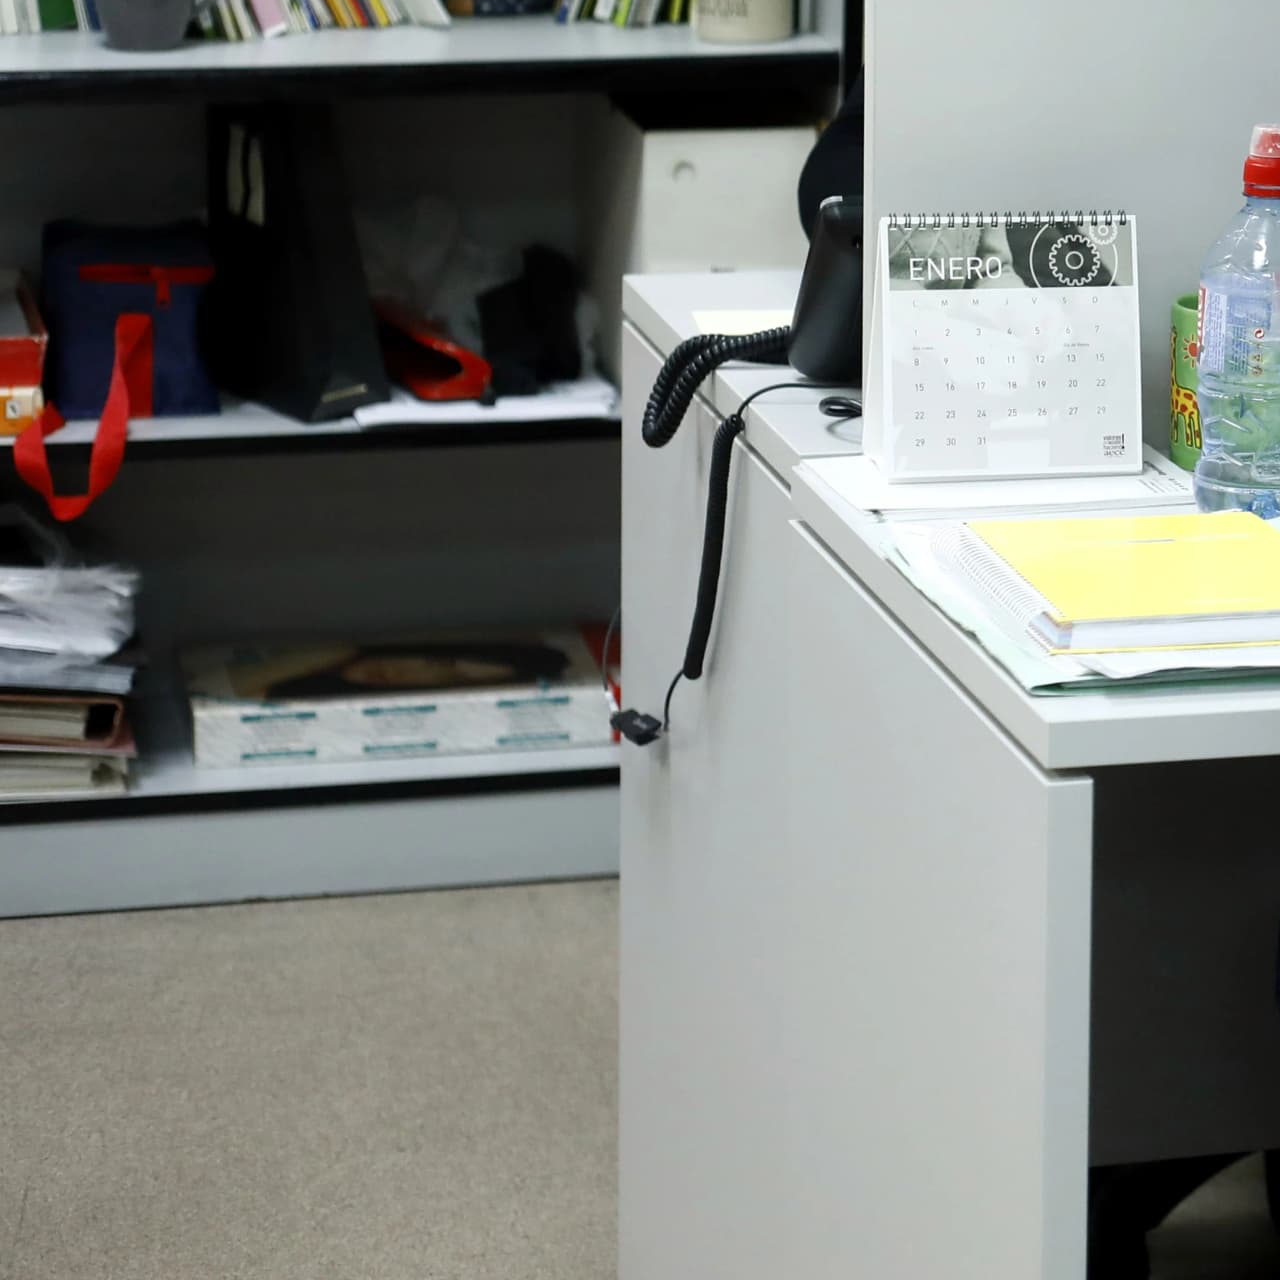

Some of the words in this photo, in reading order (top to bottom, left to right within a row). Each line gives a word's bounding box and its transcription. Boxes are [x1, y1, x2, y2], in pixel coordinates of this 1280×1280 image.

[909, 256, 1001, 281] ENERO
[976, 356, 985, 365] 10
[1007, 355, 1016, 364] 11
[1035, 355, 1046, 363] 12
[1066, 354, 1076, 363] 13
[914, 383, 925, 392] 15
[945, 383, 956, 392] 16
[976, 381, 986, 390] 17
[1007, 381, 1017, 390] 18
[1036, 380, 1047, 389] 19
[1067, 379, 1078, 388] 20
[914, 411, 925, 420] 22
[945, 410, 956, 419] 23
[976, 409, 987, 418] 24
[1007, 408, 1018, 417] 25
[1037, 408, 1048, 417] 26
[1068, 407, 1079, 416] 27
[914, 438, 925, 447] 29
[946, 437, 957, 446] 30
[976, 436, 987, 445] 31
